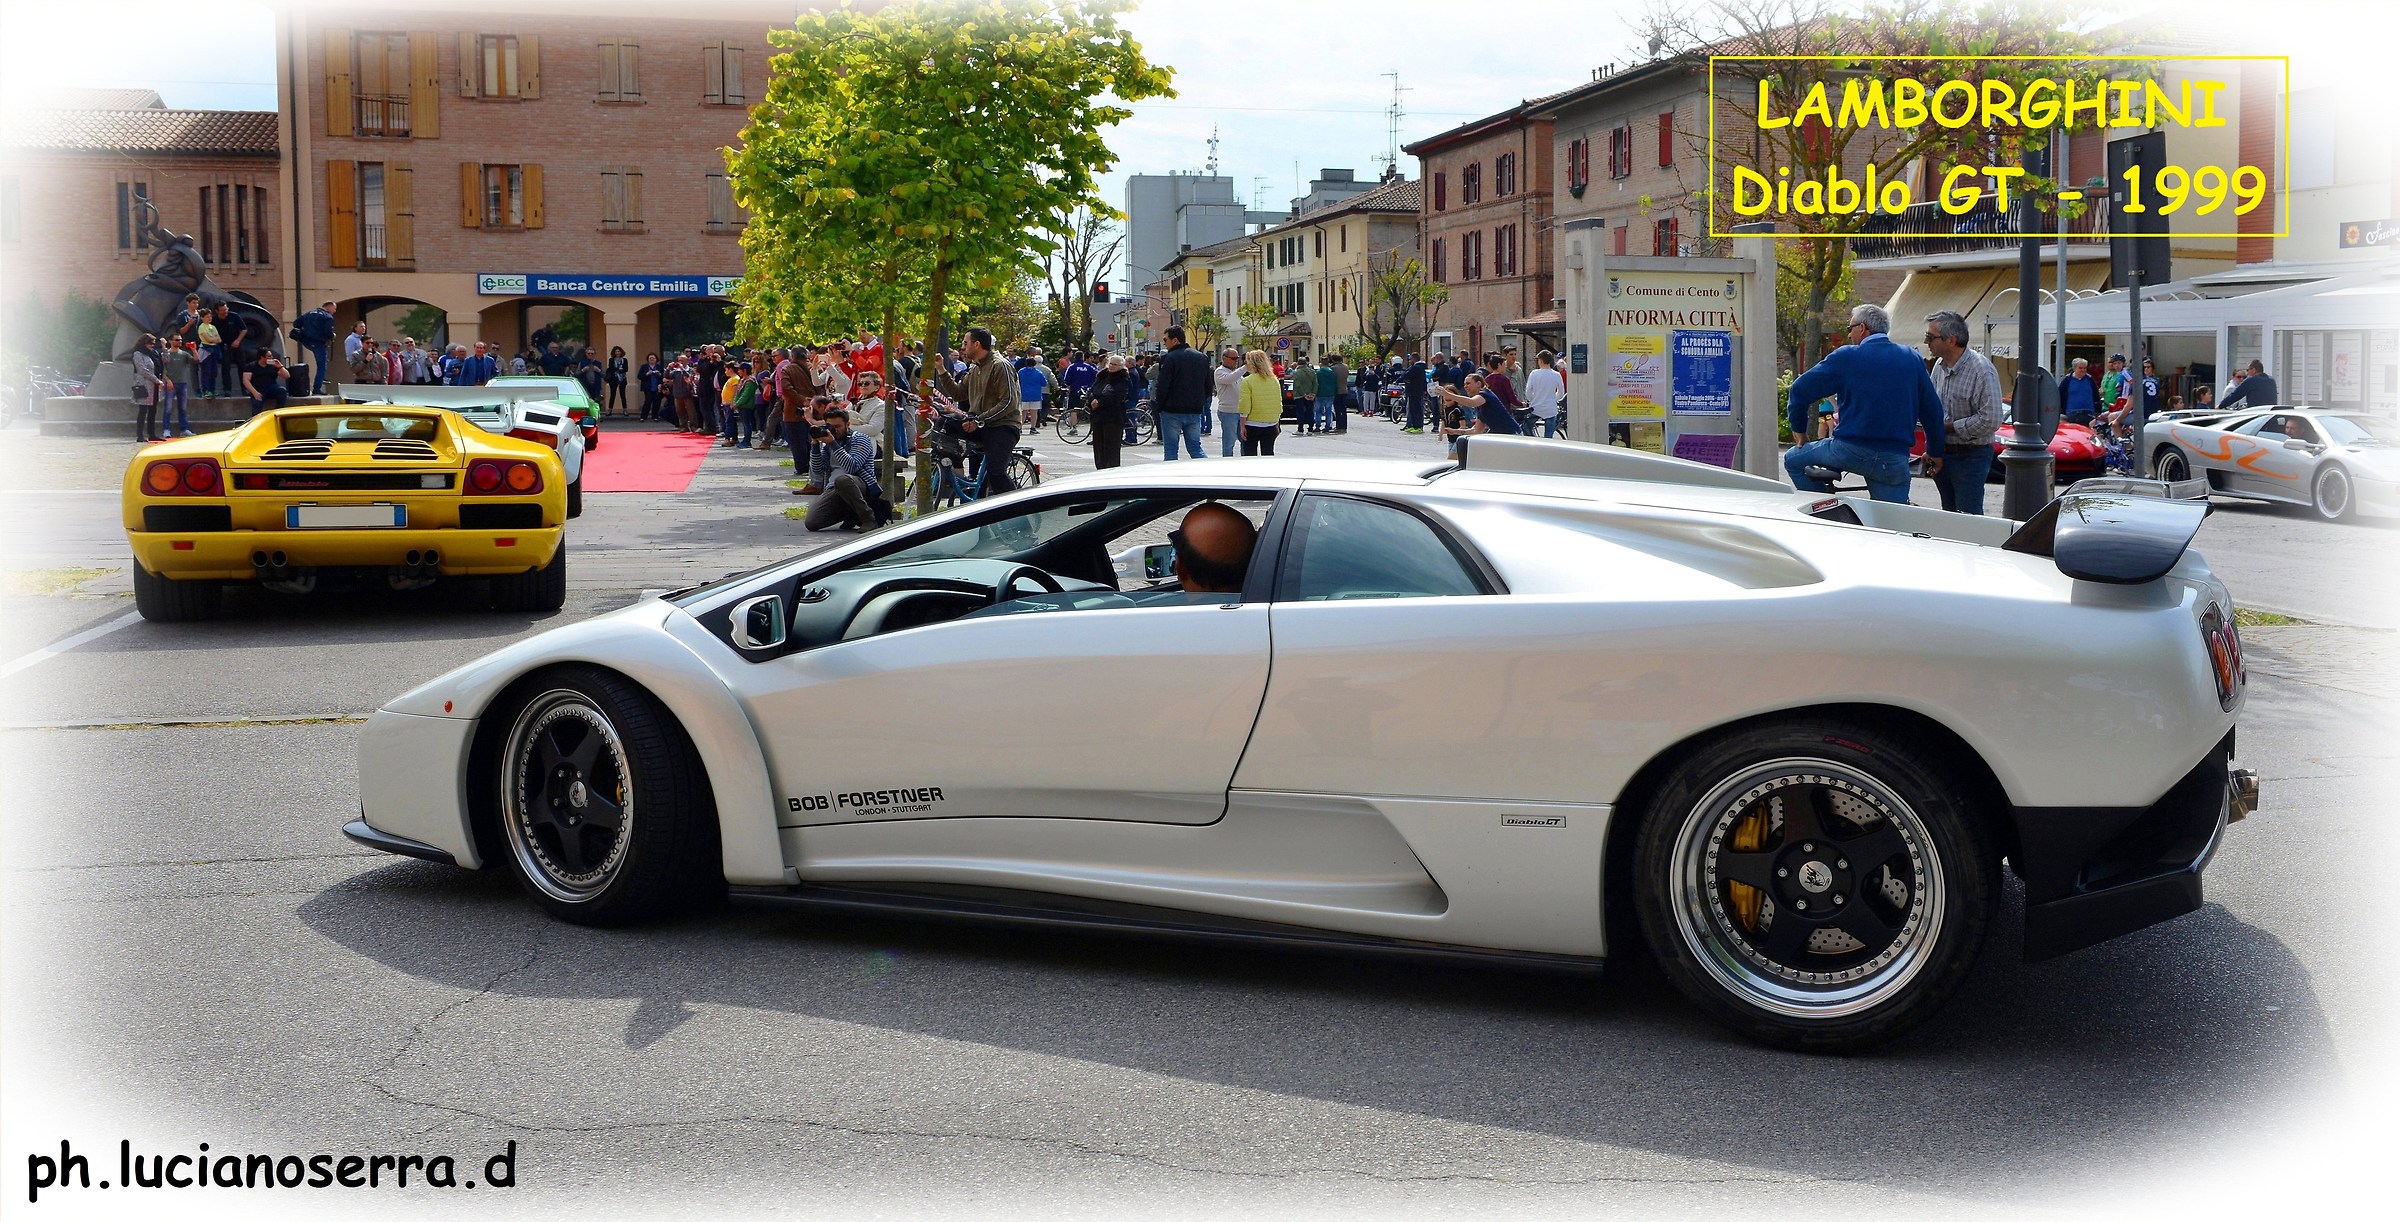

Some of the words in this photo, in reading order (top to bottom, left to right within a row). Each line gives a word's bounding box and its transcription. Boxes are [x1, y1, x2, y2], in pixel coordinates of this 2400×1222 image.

[498, 278, 524, 288] BCC
[537, 279, 587, 291] Banca
[592, 279, 645, 292] Centro
[650, 280, 698, 292] Emilia
[1626, 285, 1673, 297] Comune
[1675, 287, 1685, 297] di
[1688, 286, 1720, 298] Cento
[1607, 309, 1686, 326] INFORMA
[1689, 307, 1738, 327] CITTÀ
[2145, 381, 2156, 396] 3
[787, 795, 829, 812] BOB
[837, 787, 945, 808] FORSTNER
[854, 807, 887, 816] LONDON
[892, 804, 932, 814] STUTTGART
